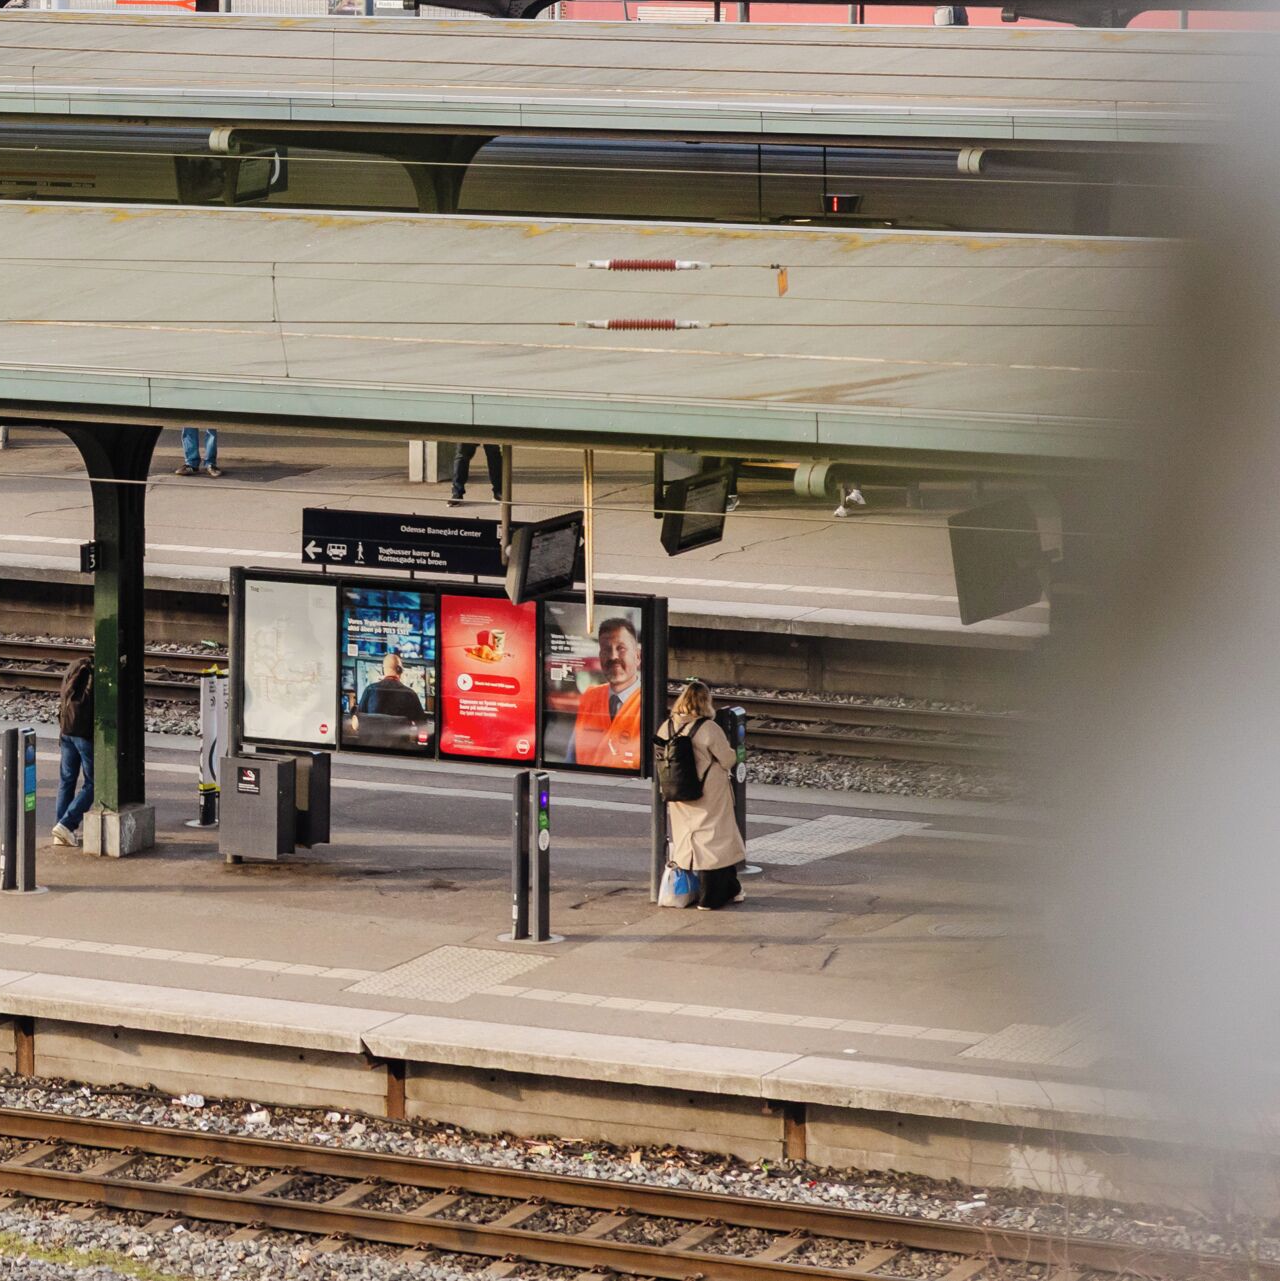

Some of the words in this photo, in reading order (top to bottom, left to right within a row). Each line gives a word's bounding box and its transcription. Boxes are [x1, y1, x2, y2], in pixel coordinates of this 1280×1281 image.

[400, 524, 426, 534] Odense
[426, 527, 459, 537] Banegård
[459, 529, 482, 538] Center
[378, 546, 411, 557] Togbusser
[430, 550, 440, 559] fra
[378, 555, 415, 565] Kottesgade
[416, 557, 427, 565] via
[428, 558, 447, 567] broen
